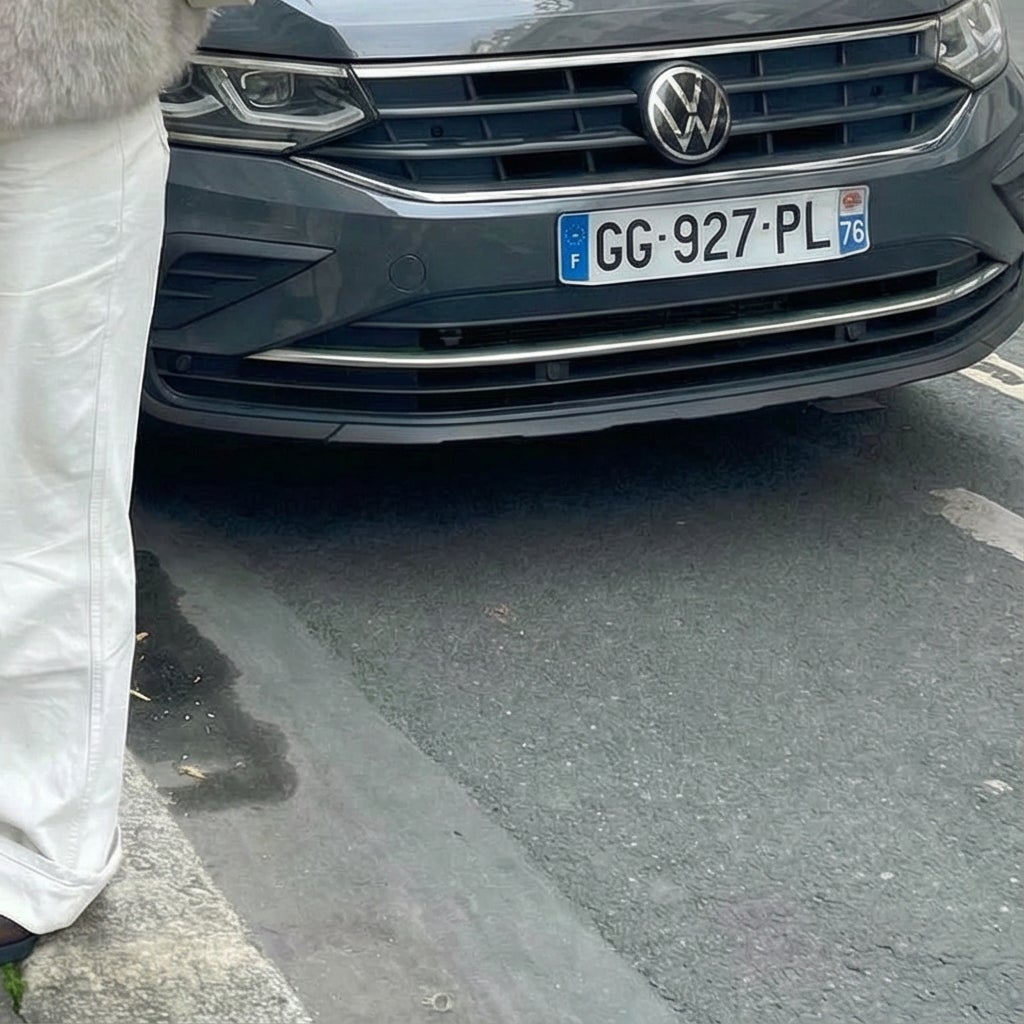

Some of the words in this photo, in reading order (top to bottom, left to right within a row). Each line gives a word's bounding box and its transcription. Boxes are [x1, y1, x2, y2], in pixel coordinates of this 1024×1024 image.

[649, 69, 726, 156] VW
[570, 253, 580, 269] F
[839, 219, 865, 246] 76
